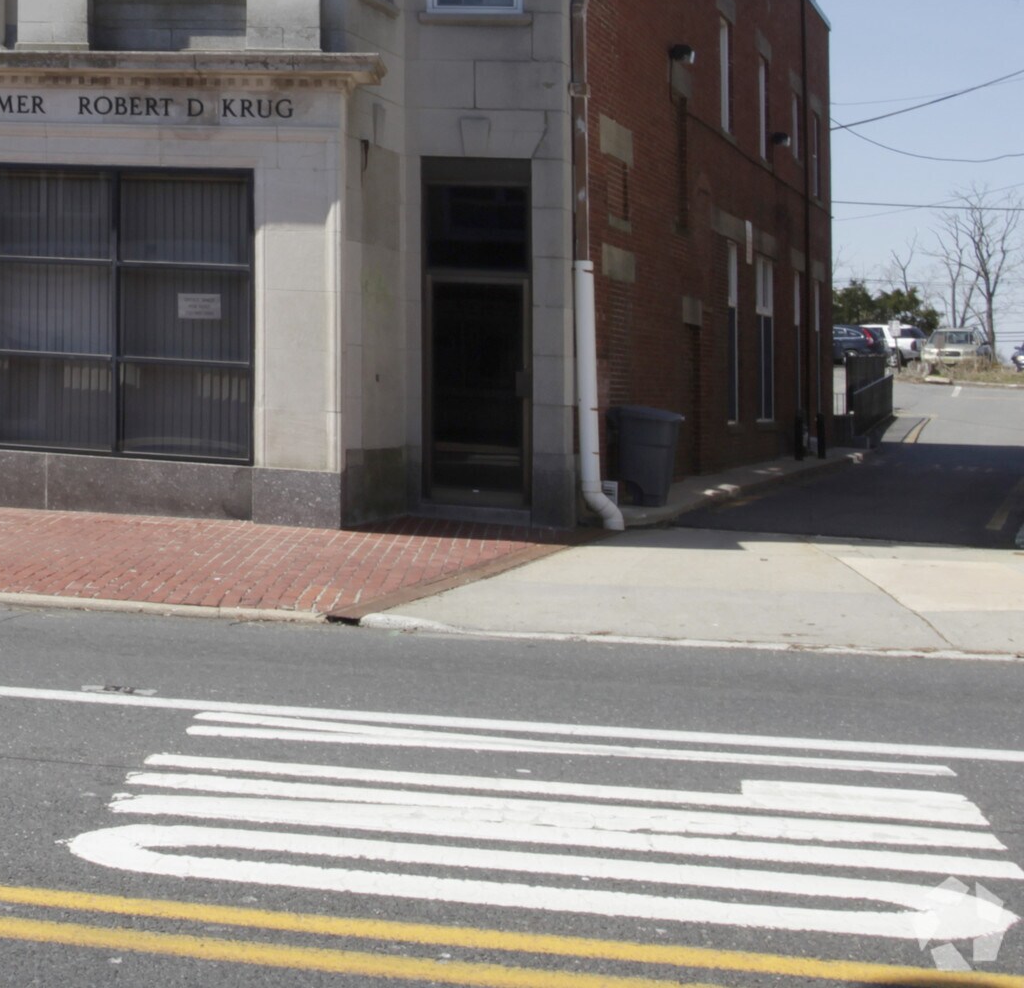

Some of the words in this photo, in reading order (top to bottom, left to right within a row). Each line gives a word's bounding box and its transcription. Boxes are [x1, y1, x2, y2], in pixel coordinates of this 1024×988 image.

[78, 96, 173, 116] ROBERT
[187, 98, 204, 117] D
[222, 99, 293, 118] KRUG
